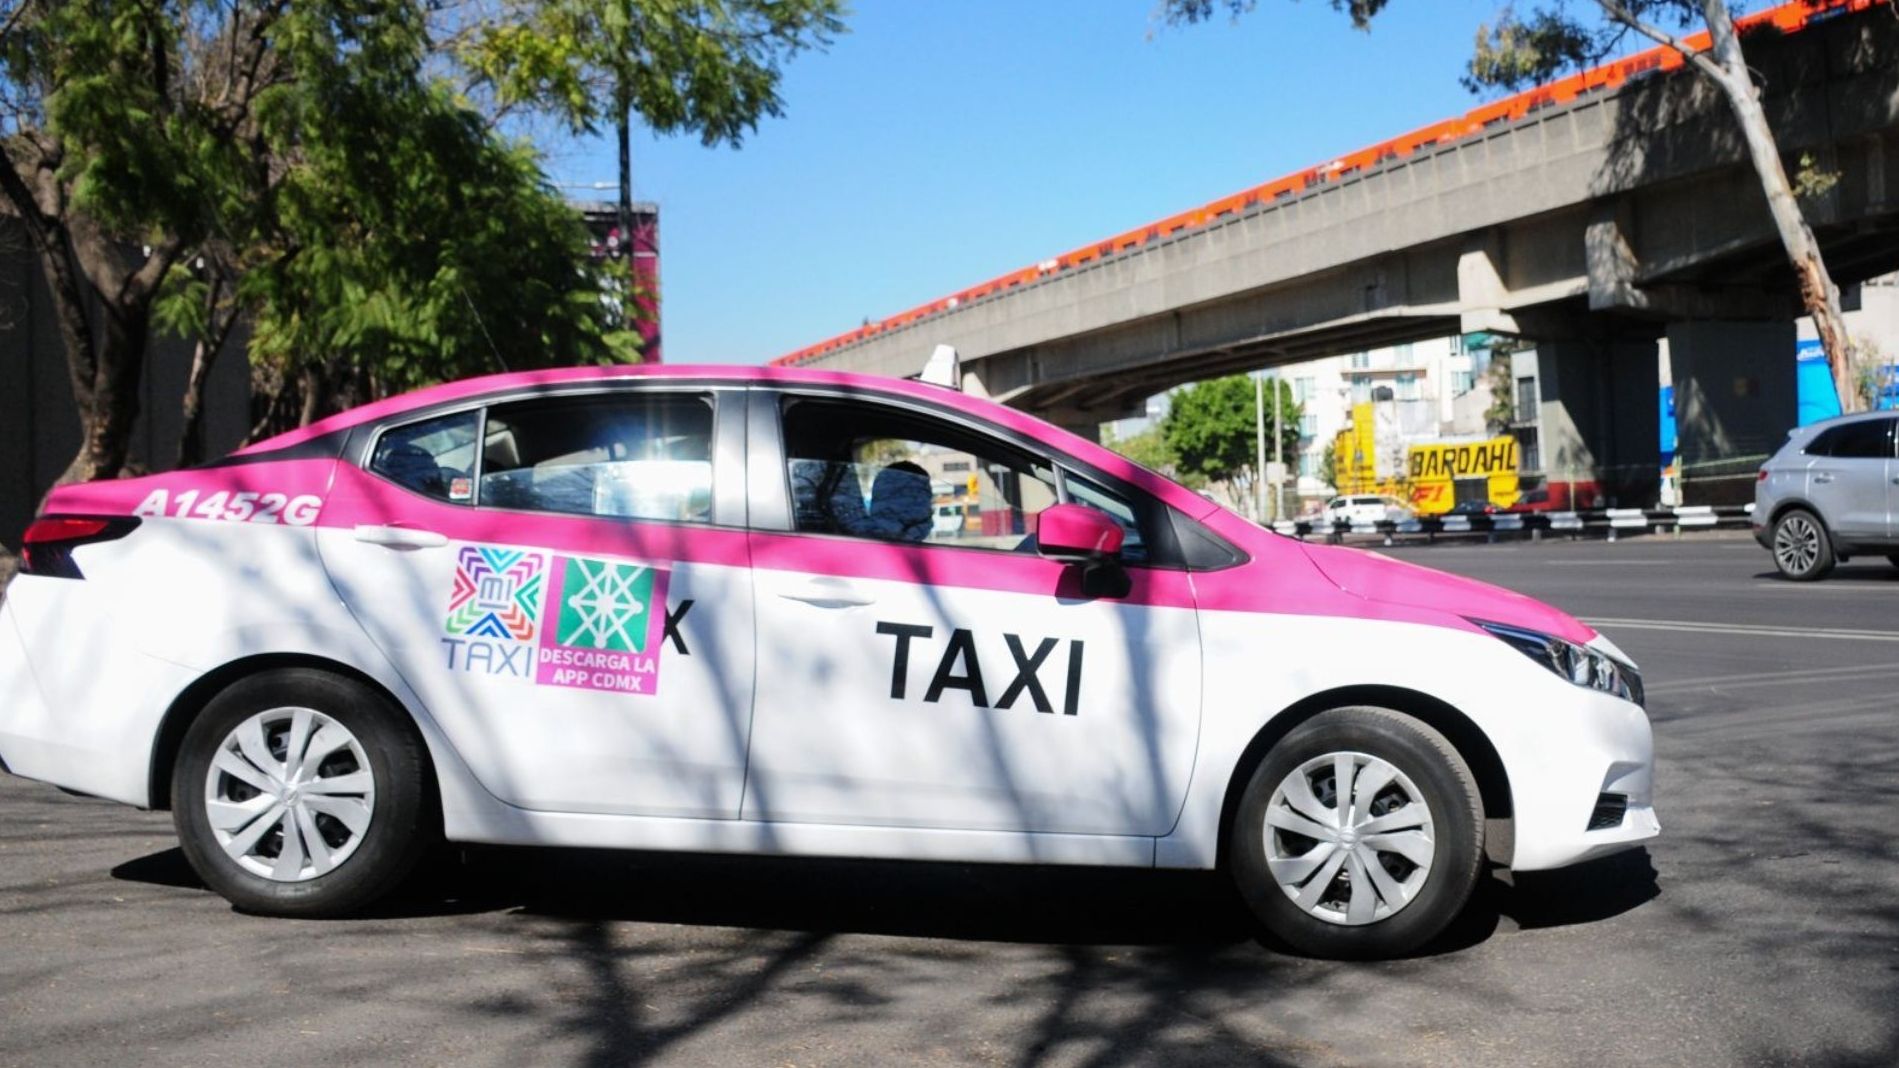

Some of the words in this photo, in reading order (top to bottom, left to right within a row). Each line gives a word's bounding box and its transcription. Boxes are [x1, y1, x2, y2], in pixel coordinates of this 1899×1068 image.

[1410, 442, 1517, 477] BARDAHL
[132, 488, 322, 526] A1452G
[441, 638, 532, 677] TAXI
[540, 649, 630, 671] DESCARGA
[633, 657, 656, 674] LA
[876, 621, 1084, 716] TAXI
[552, 668, 588, 685] APP
[592, 672, 642, 691] CDMX
